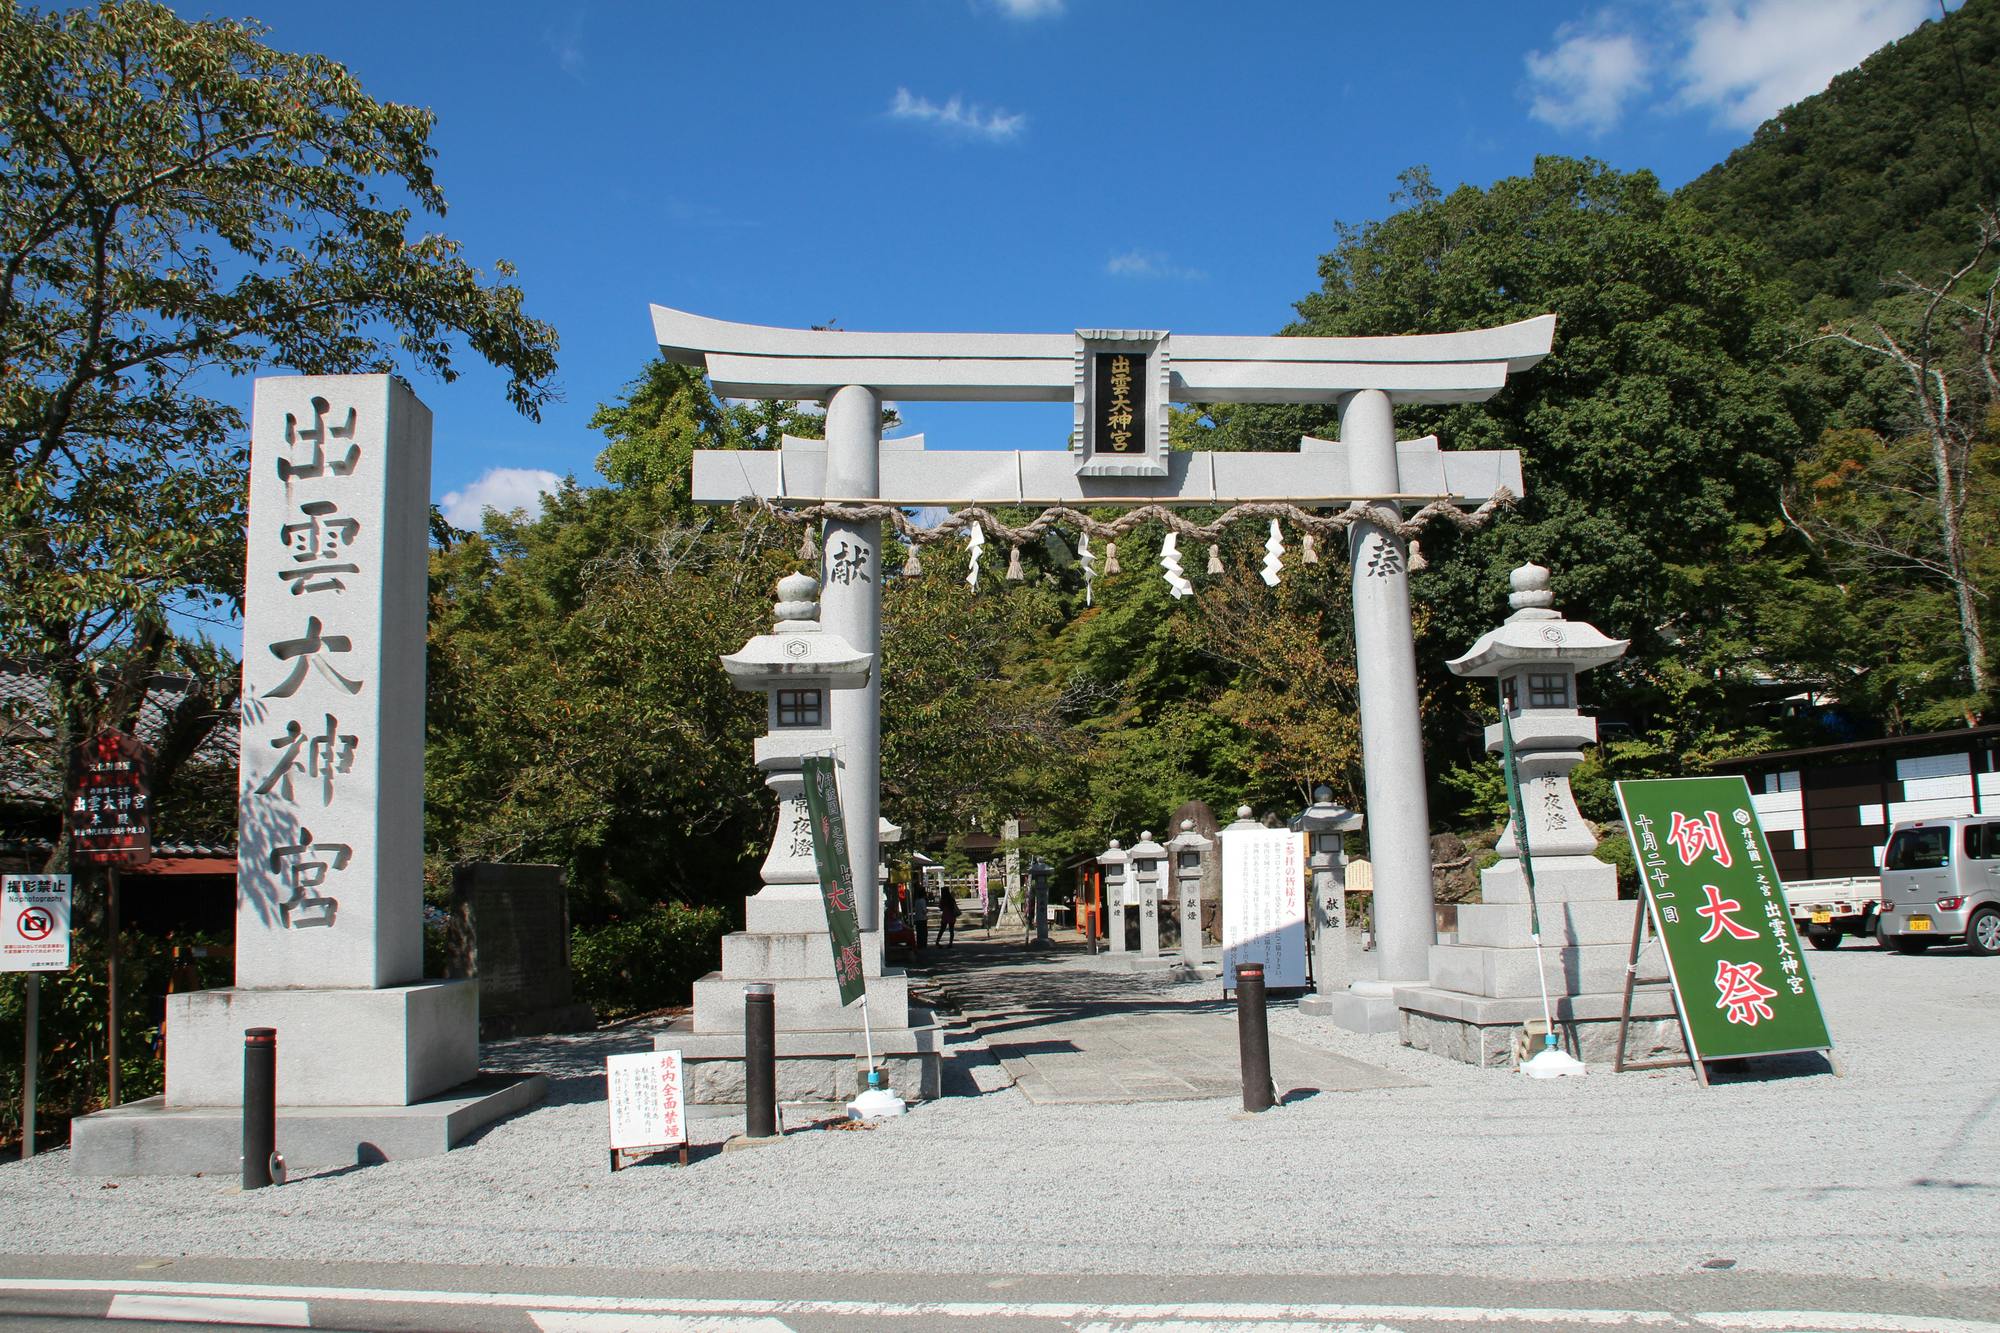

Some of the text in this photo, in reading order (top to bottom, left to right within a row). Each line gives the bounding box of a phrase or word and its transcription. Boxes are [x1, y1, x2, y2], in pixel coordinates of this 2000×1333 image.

[1107, 354, 1133, 452] 出雲大神宮
[254, 396, 364, 930] 出雲大神宮
[73, 793, 147, 812] 出雲大神宮
[790, 793, 814, 857] 常夜燈
[1541, 771, 1567, 832] 常夜燈
[7, 880, 66, 893] 撮影禁止
[1634, 814, 1679, 924] 十月二十一日
[1187, 898, 1197, 920] 献燈
[1326, 897, 1340, 928] 献燈
[1666, 810, 1778, 1026] 例大祭
[1764, 900, 1804, 995] 出雲大神宮
[661, 1056, 679, 1137] 境内全面禁煙
